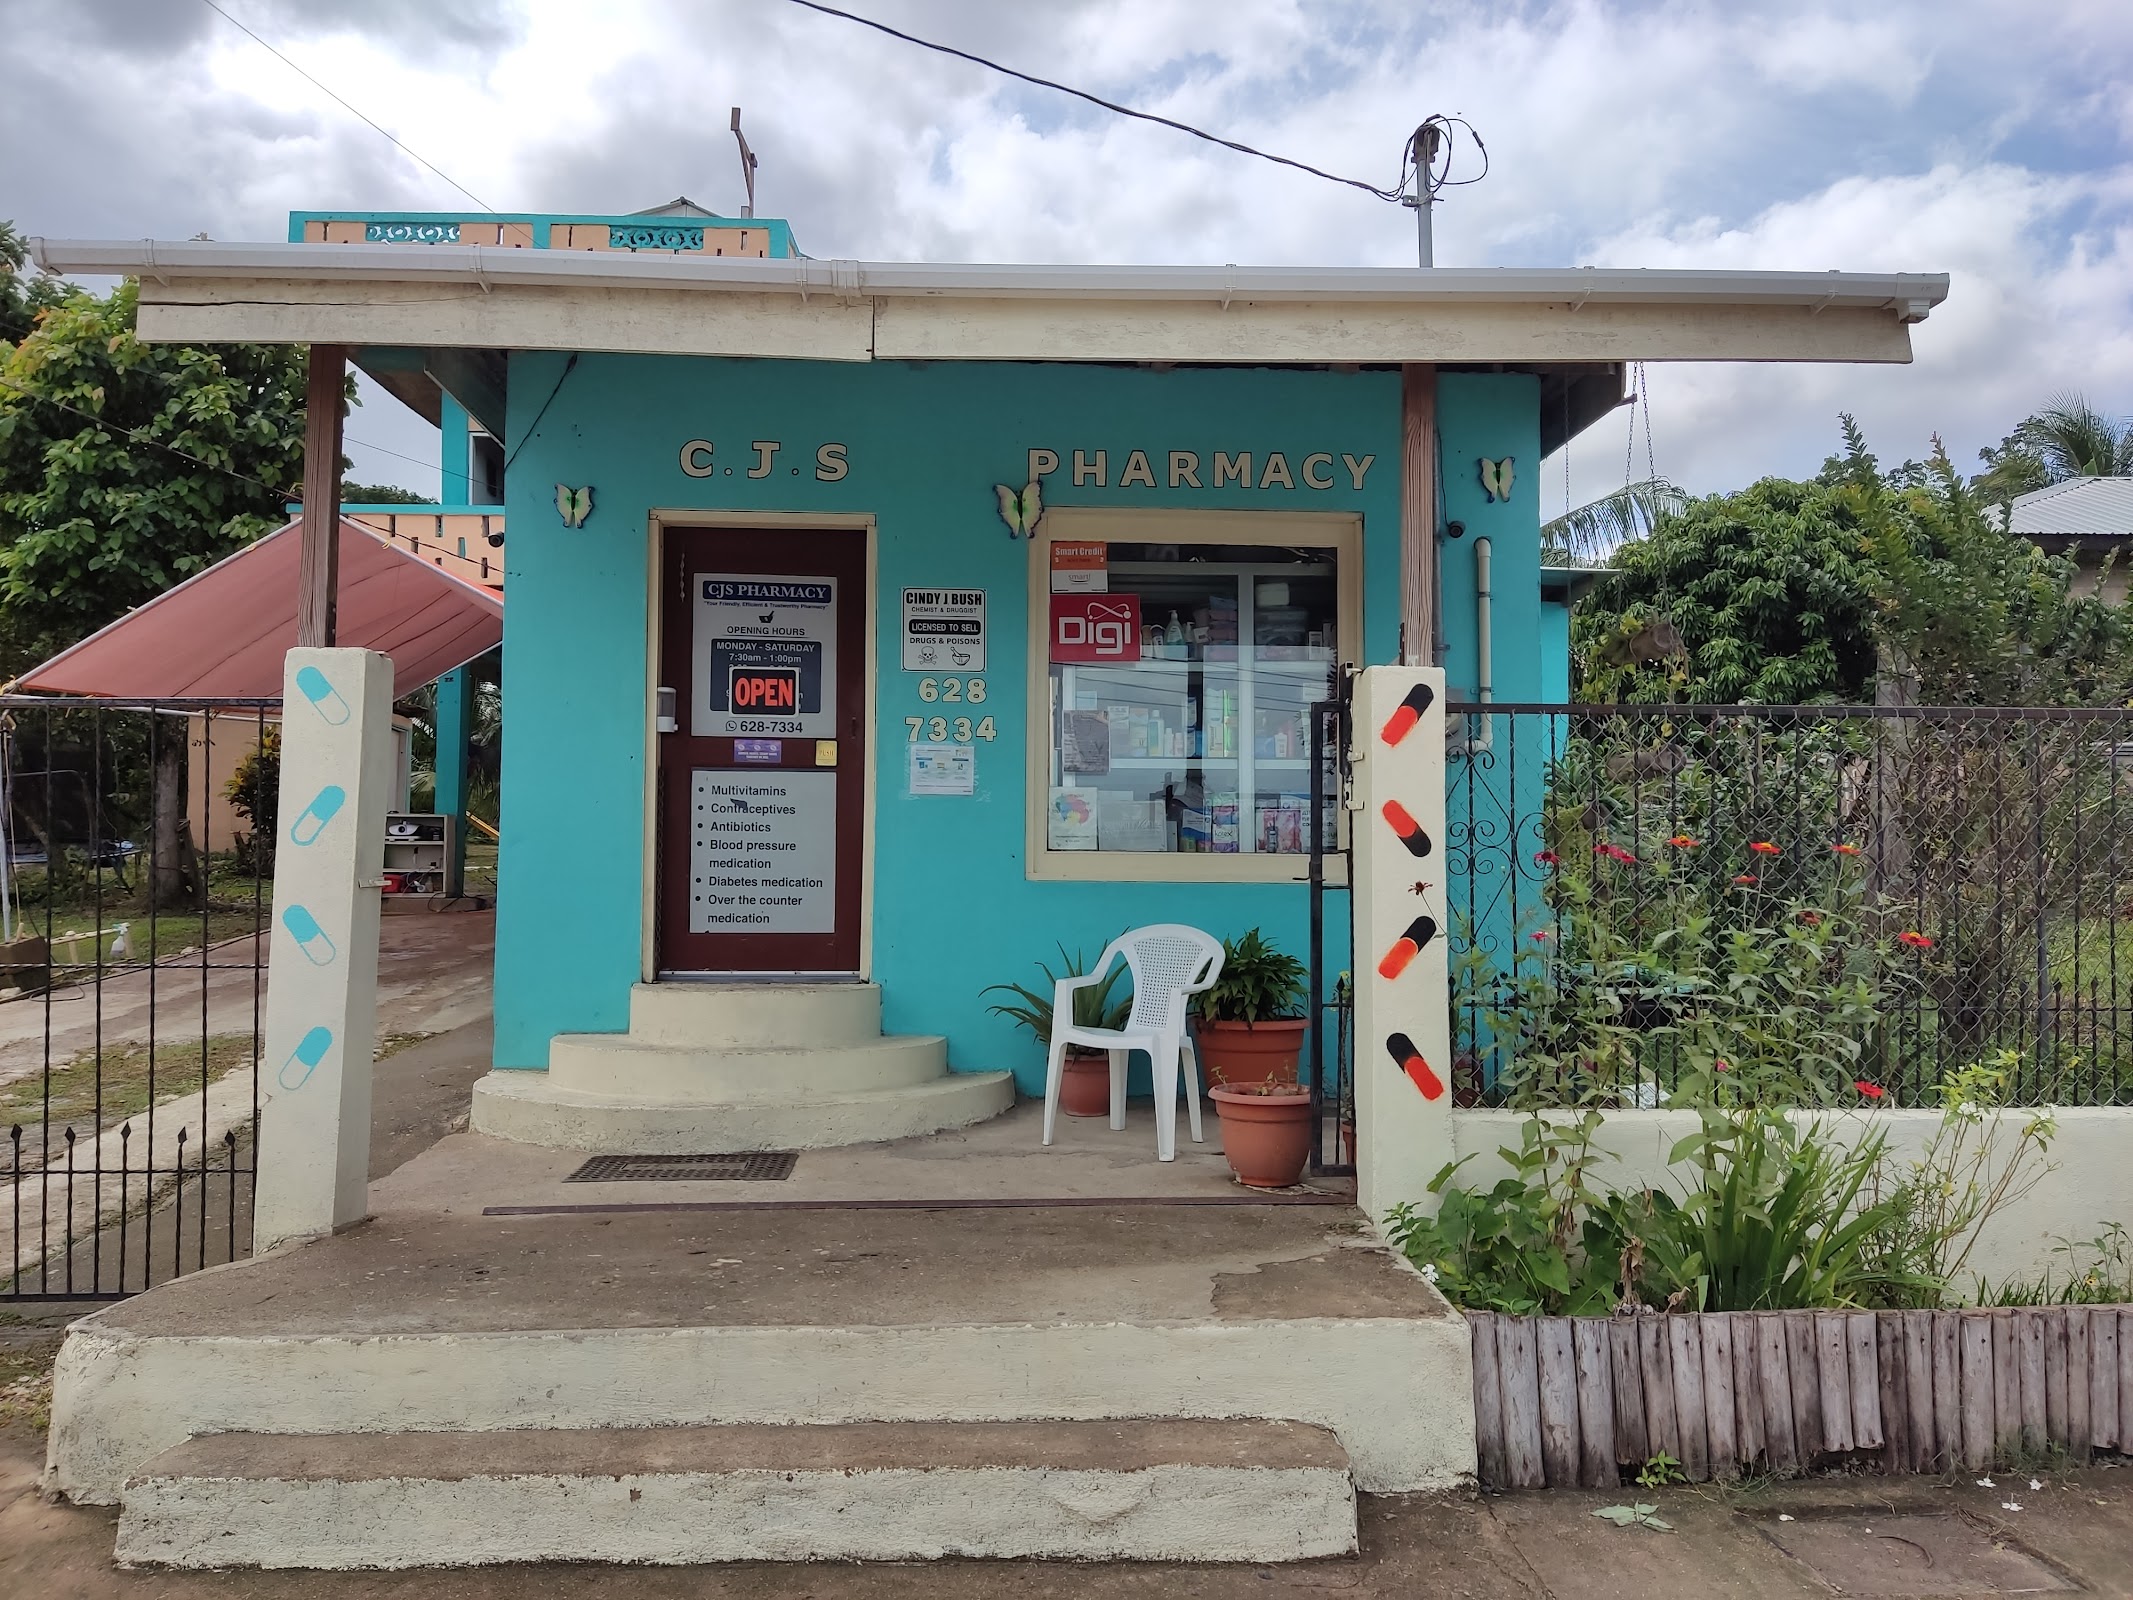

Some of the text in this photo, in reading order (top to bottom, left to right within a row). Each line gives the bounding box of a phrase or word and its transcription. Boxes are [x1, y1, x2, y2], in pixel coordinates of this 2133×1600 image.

[1027, 447, 1377, 490] PHARMACY
[1055, 547, 1103, 556] Smart Credit
[708, 583, 827, 599] CJS PHARMACY
[905, 592, 941, 606] CINDY
[951, 593, 982, 606] BUSH
[727, 625, 805, 636] OPENING HOURS
[912, 622, 978, 633] LICENSED TO SELL
[1058, 611, 1131, 654] Digi
[716, 642, 758, 651] MONDAY
[765, 643, 815, 652] SATURDAY
[910, 637, 937, 645] DRUGS
[946, 637, 981, 645] POISONS
[729, 653, 761, 662] 7:30am
[770, 655, 801, 664] 1:00pm
[735, 677, 793, 707] OPEN
[918, 677, 987, 704] 628
[740, 721, 803, 733] 628-7334
[904, 716, 998, 742] 7334
[711, 785, 787, 796] Multivitamins
[710, 821, 771, 832] Antibiotics
[710, 839, 797, 852] Blood pressure
[709, 858, 771, 869] medication
[709, 876, 823, 888] Diabetes medication
[708, 894, 802, 906] Over the counter
[707, 913, 770, 924] medication
